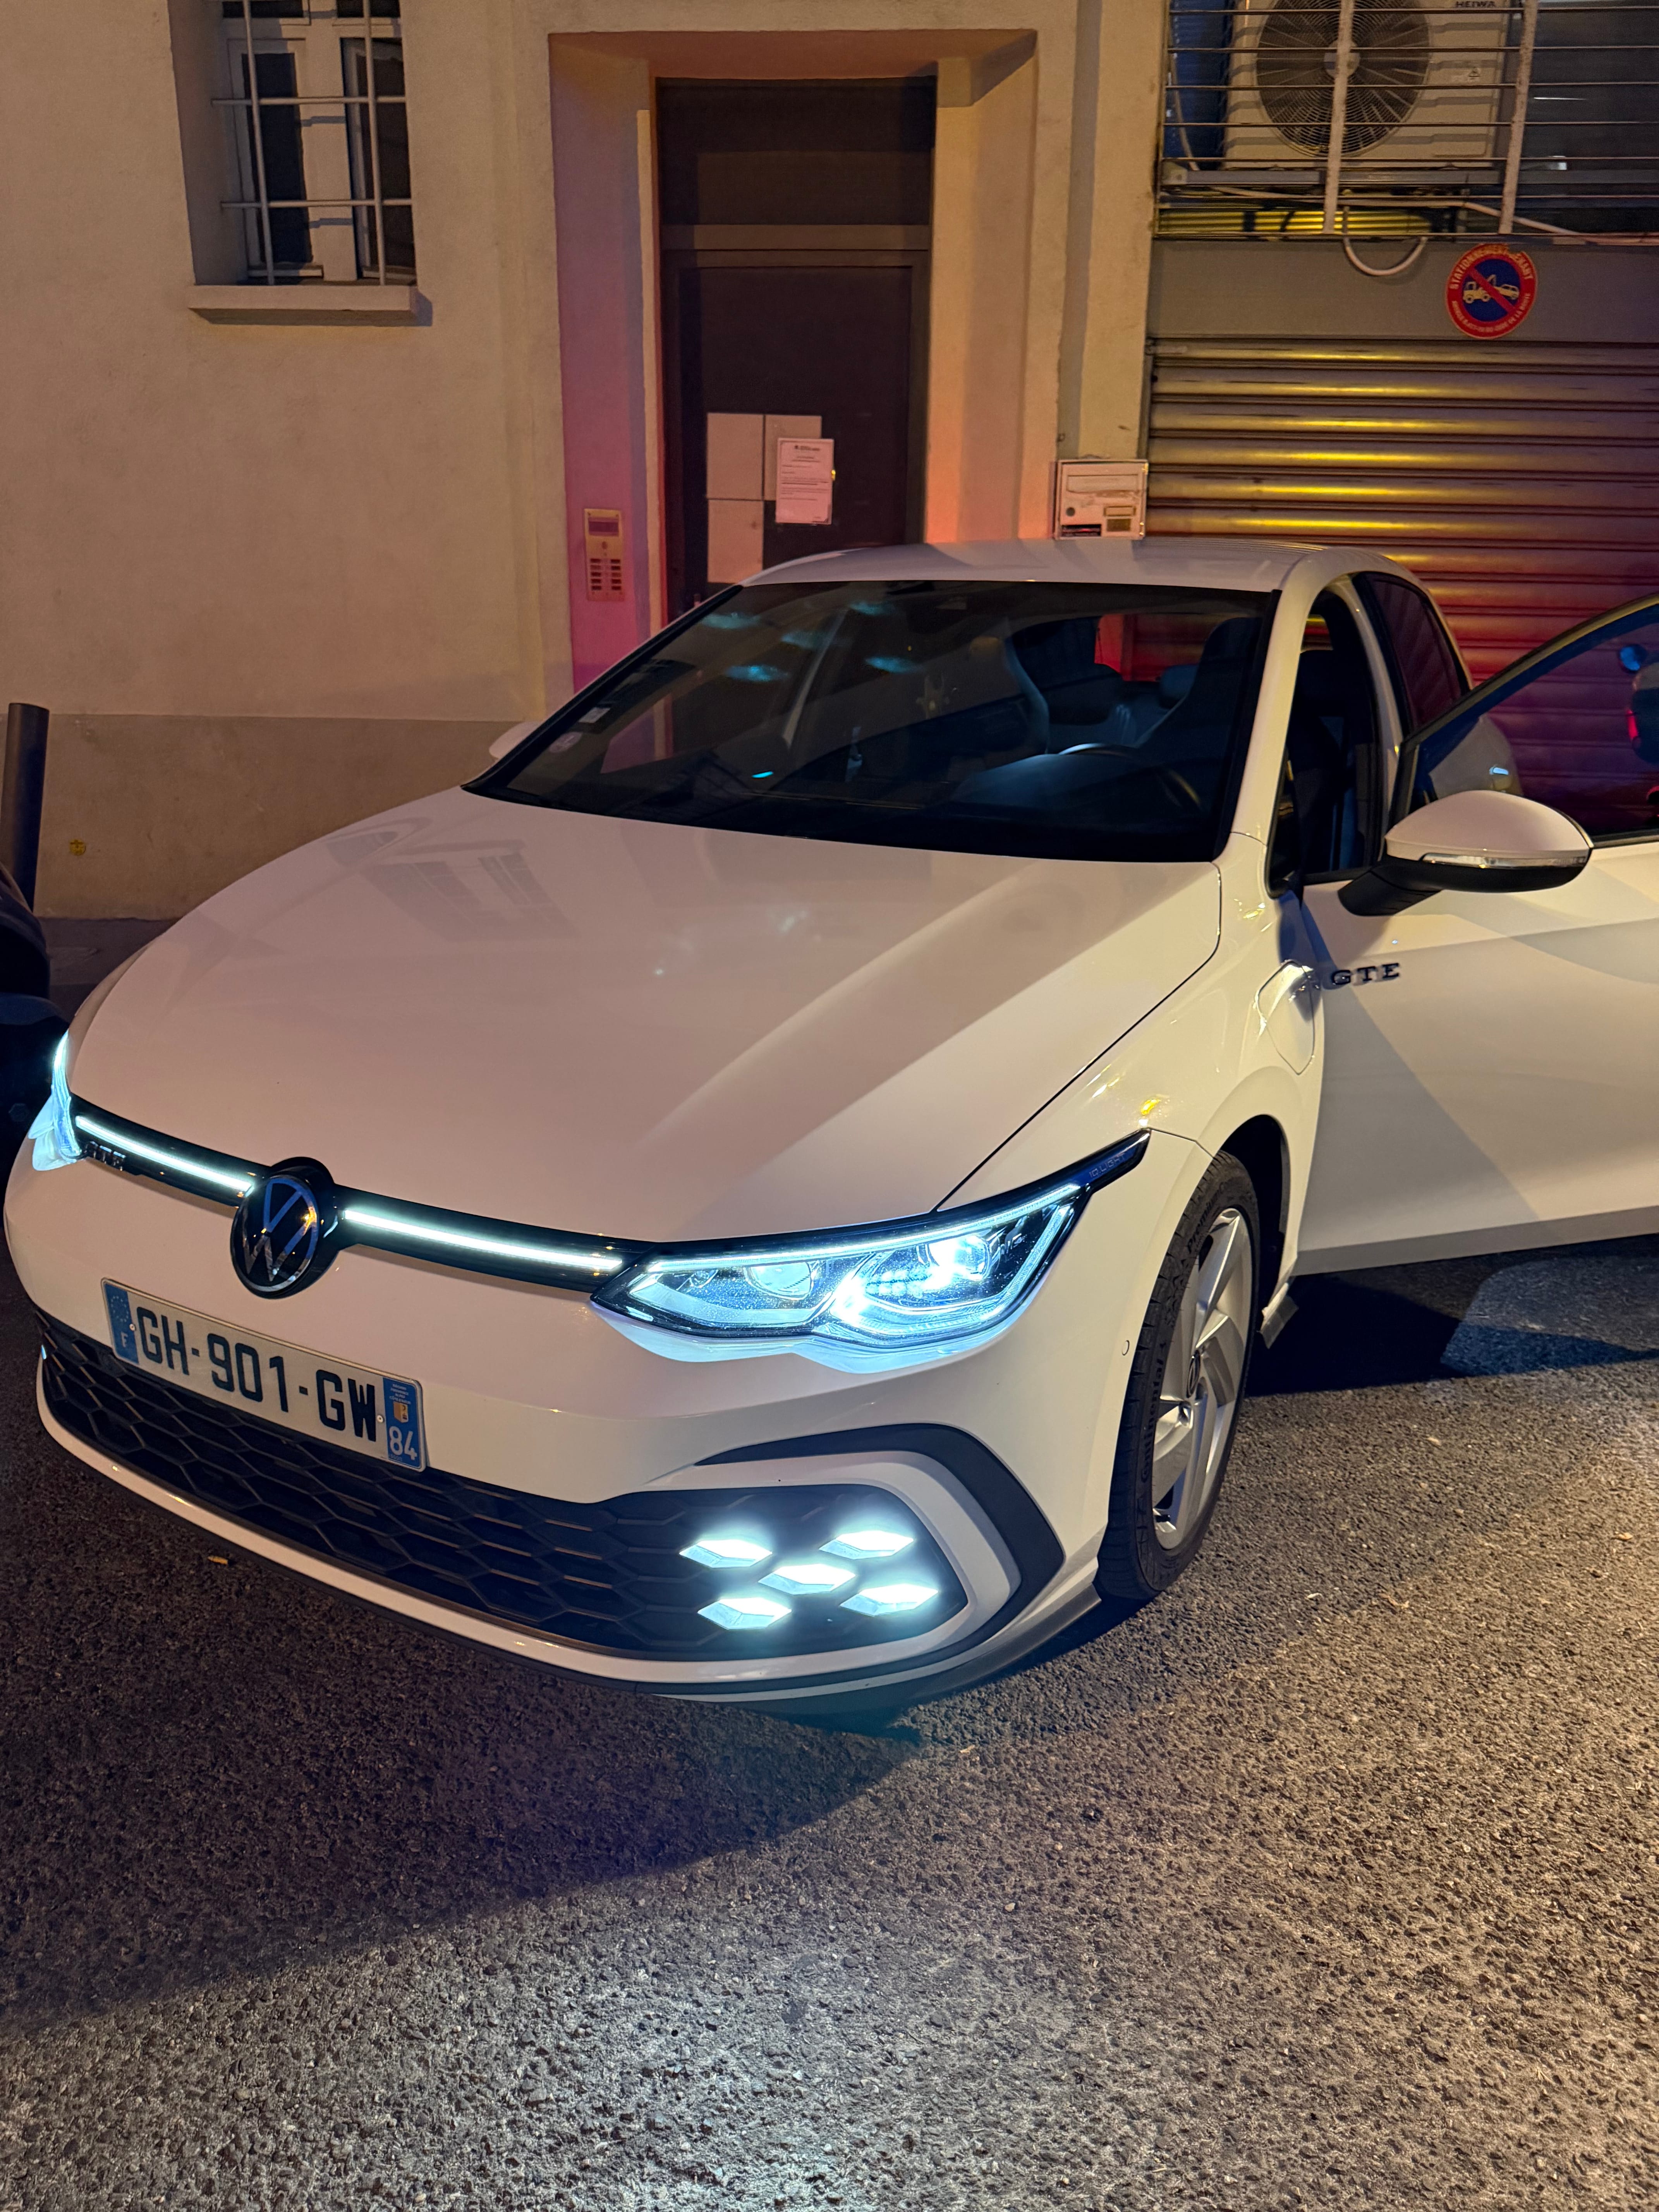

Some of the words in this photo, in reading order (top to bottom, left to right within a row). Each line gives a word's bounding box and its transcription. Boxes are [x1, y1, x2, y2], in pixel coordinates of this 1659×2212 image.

[1331, 962, 1400, 985] GTE
[121, 1331, 128, 1348] F
[136, 1306, 376, 1443] GH-901-GW
[389, 1425, 417, 1461] 84
